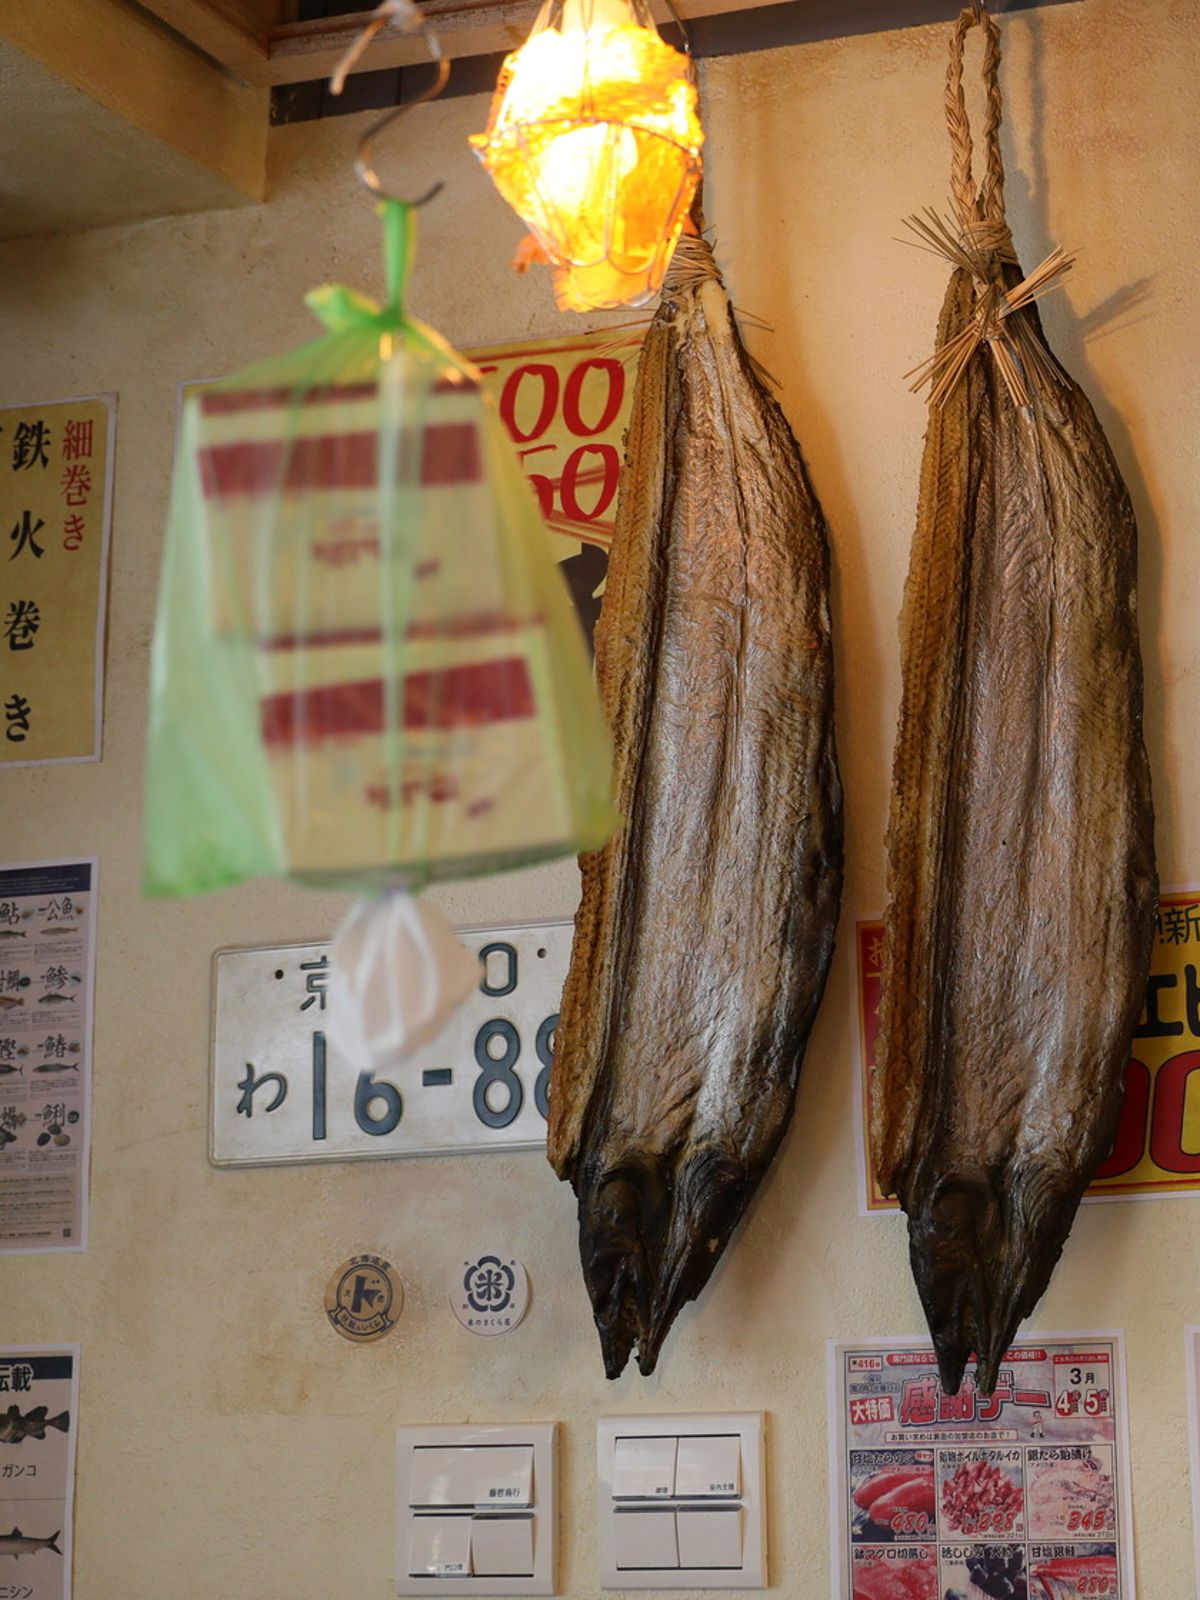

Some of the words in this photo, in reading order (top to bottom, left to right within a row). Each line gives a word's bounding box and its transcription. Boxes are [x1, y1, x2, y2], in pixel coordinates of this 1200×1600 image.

[60, 419, 94, 551] 細巻き
[4, 419, 51, 742] 鉄火巻き
[237, 1062, 287, 1118] わ
[852, 1399, 892, 1422] 大特価
